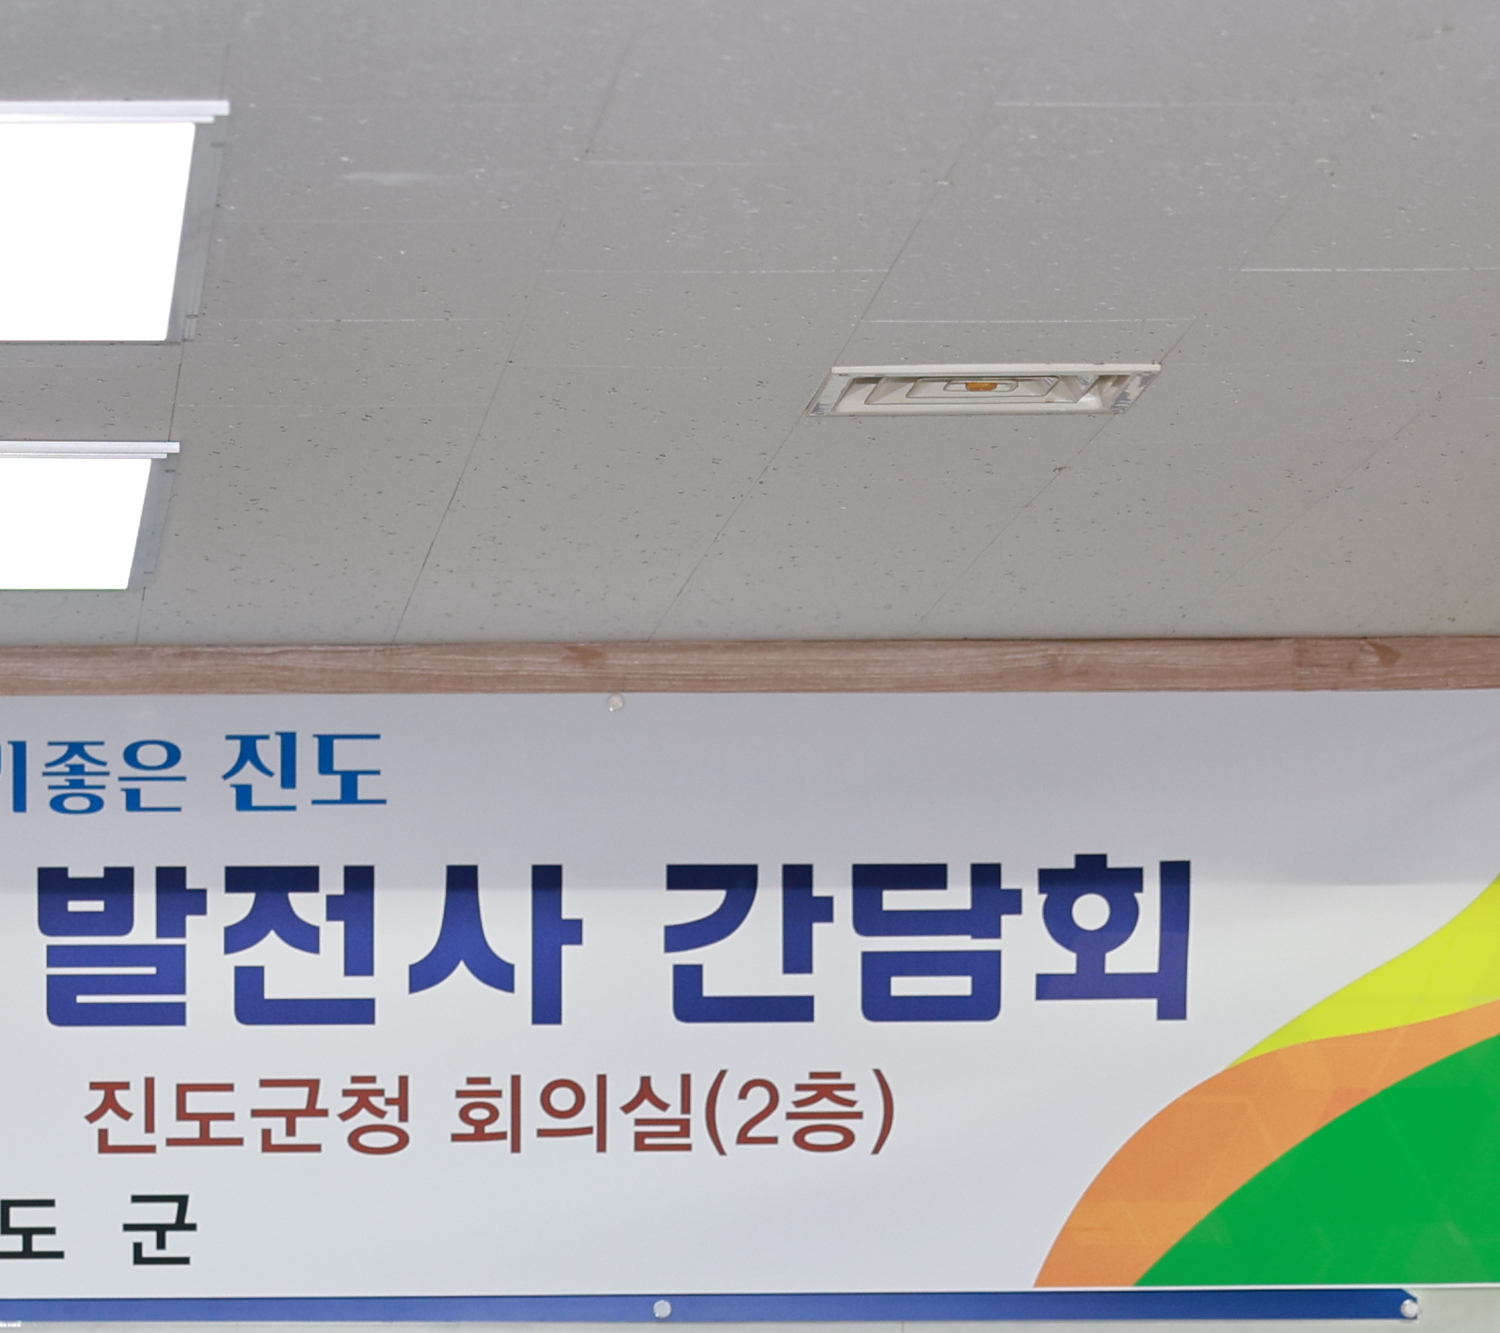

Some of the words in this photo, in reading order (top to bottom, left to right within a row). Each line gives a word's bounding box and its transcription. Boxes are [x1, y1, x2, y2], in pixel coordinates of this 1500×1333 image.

[220, 731, 389, 813] 진도
[35, 862, 585, 1028] 발전사
[662, 852, 1193, 1025] 간담회
[83, 1075, 411, 1158] 진도군청
[449, 1064, 896, 1160] 회의실(2층)
